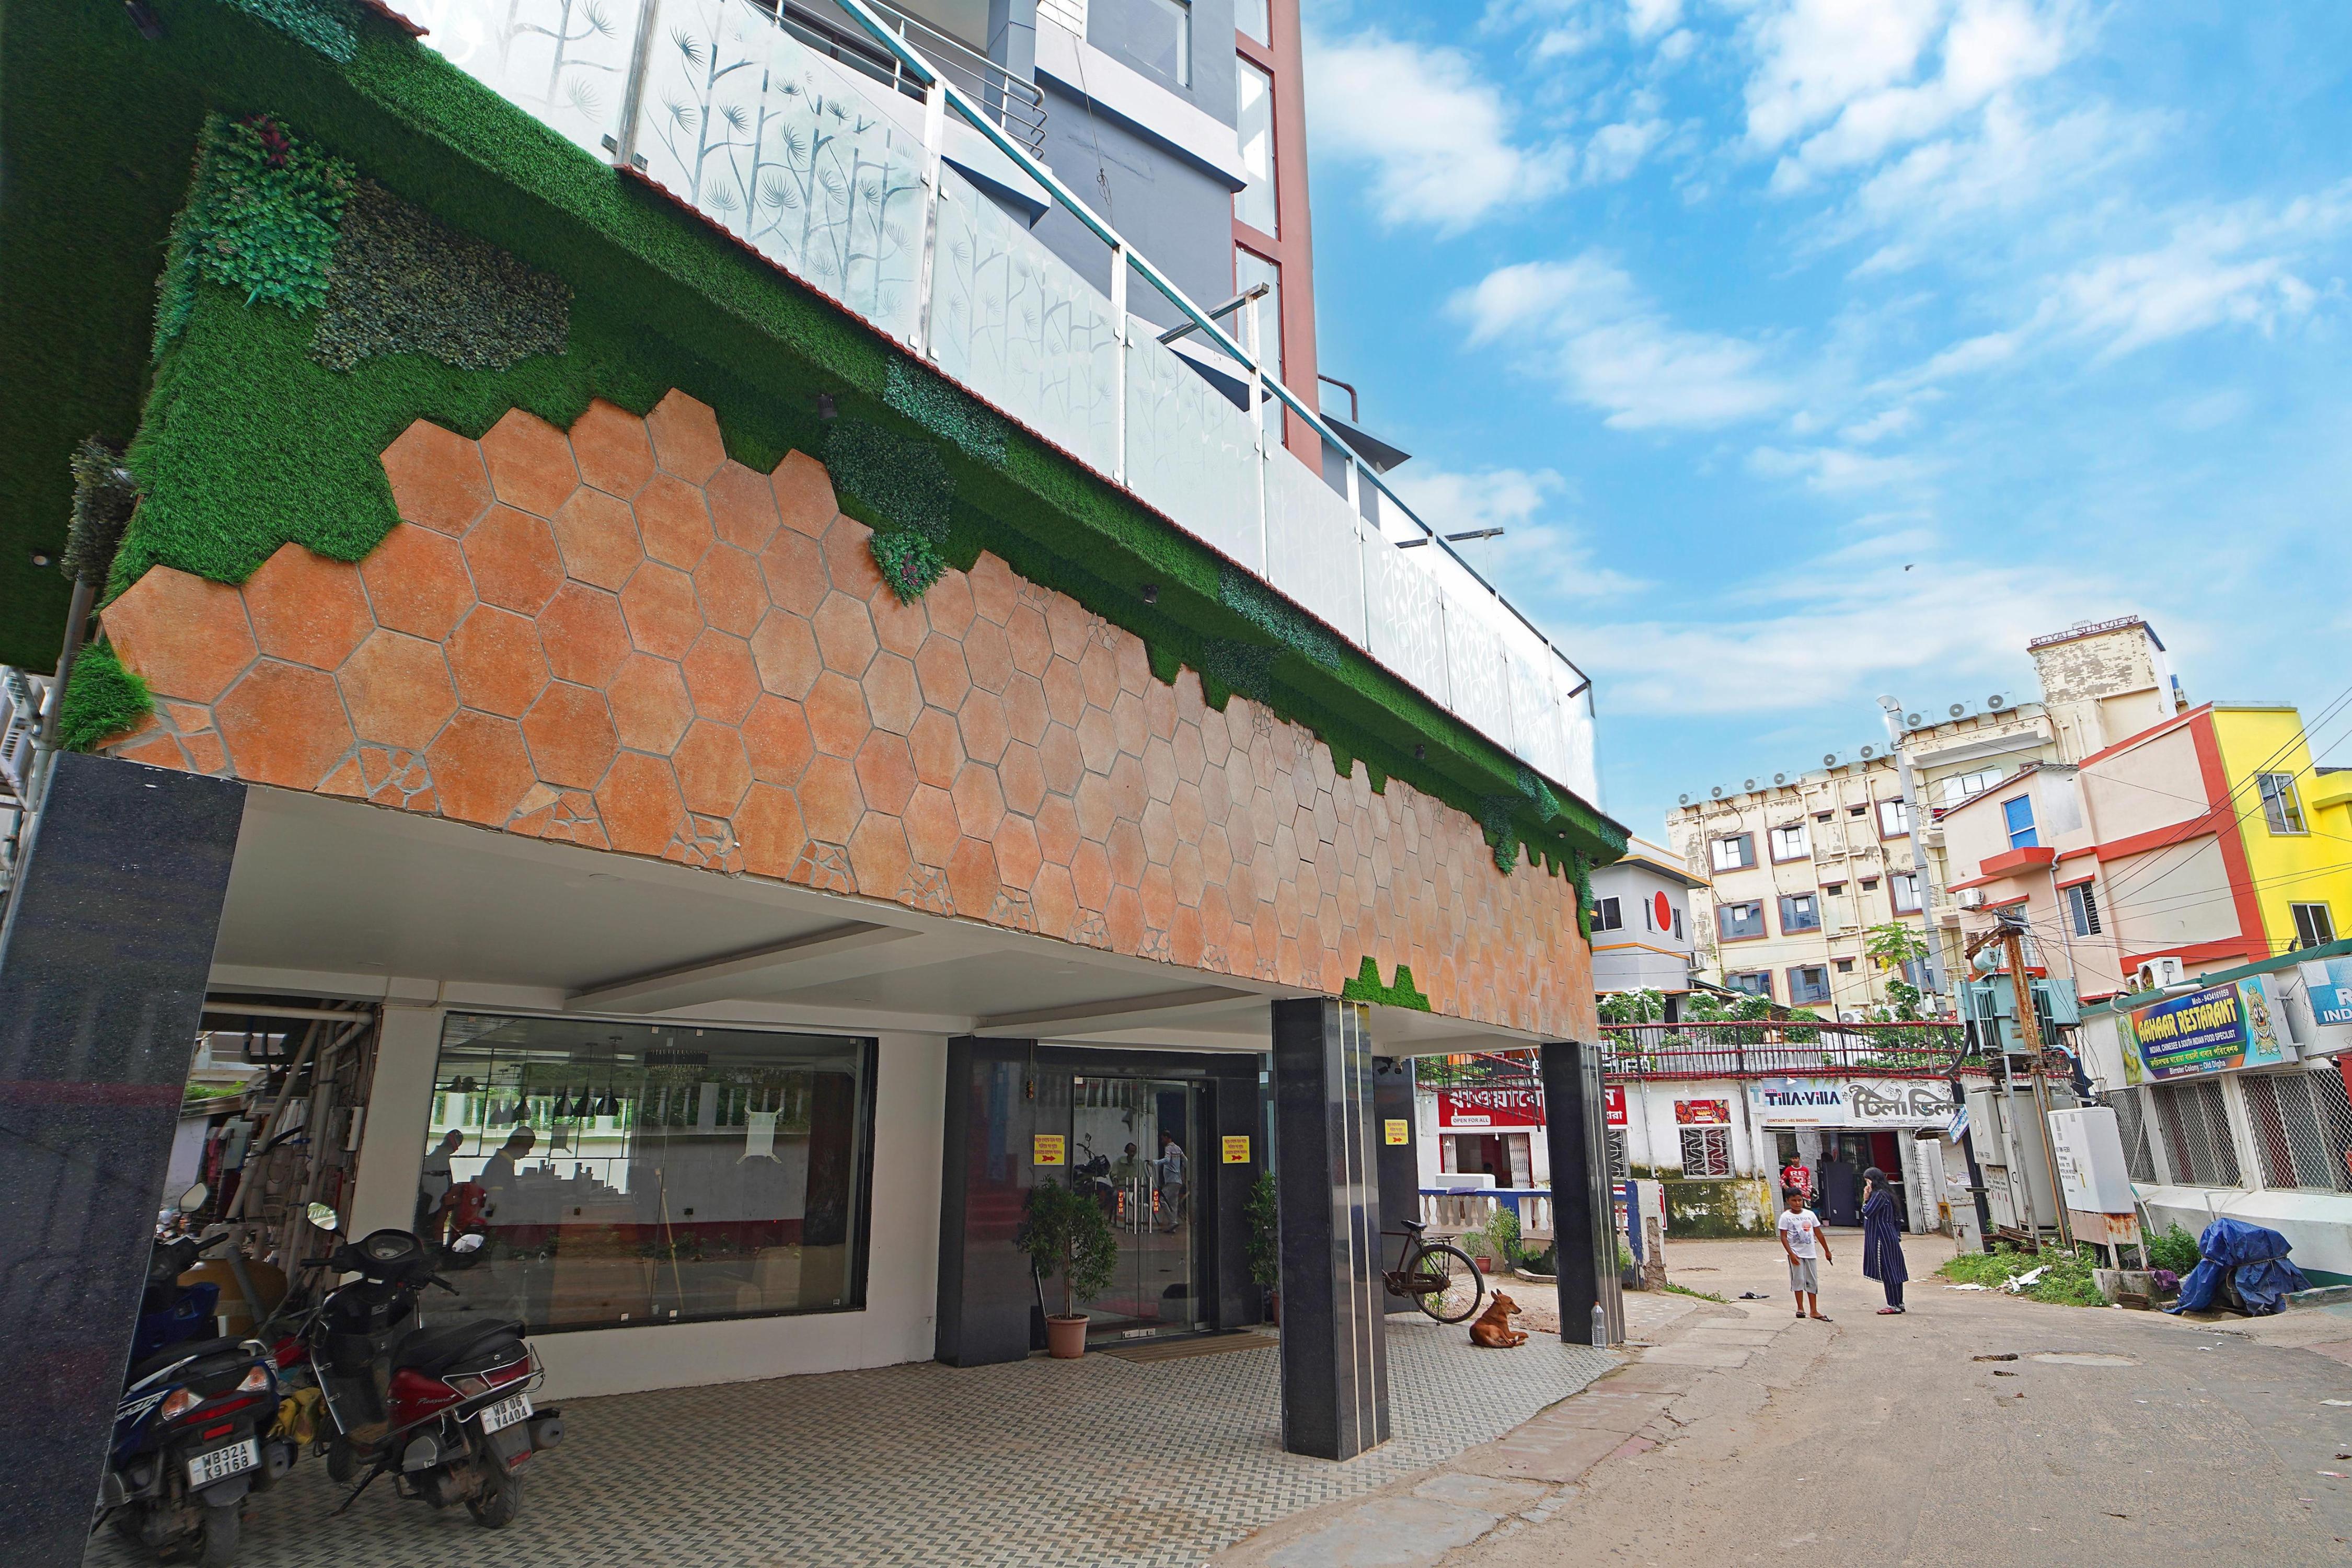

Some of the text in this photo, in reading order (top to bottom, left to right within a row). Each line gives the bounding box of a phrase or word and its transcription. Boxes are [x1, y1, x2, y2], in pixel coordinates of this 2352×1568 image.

[2138, 997, 2237, 1044] AAHAAR RESTARANT
[2181, 1039, 2193, 1048] SOUTH
[2193, 1036, 2205, 1046] INDIAN
[2205, 1034, 2215, 1043] FOOD
[2185, 1064, 2199, 1073] Colony
[2212, 1059, 2226, 1070] Digha
[492, 1396, 523, 1417] WB 06
[494, 1406, 527, 1428] V4404
[202, 1444, 247, 1469] WB32A
[204, 1456, 249, 1481] K9168
